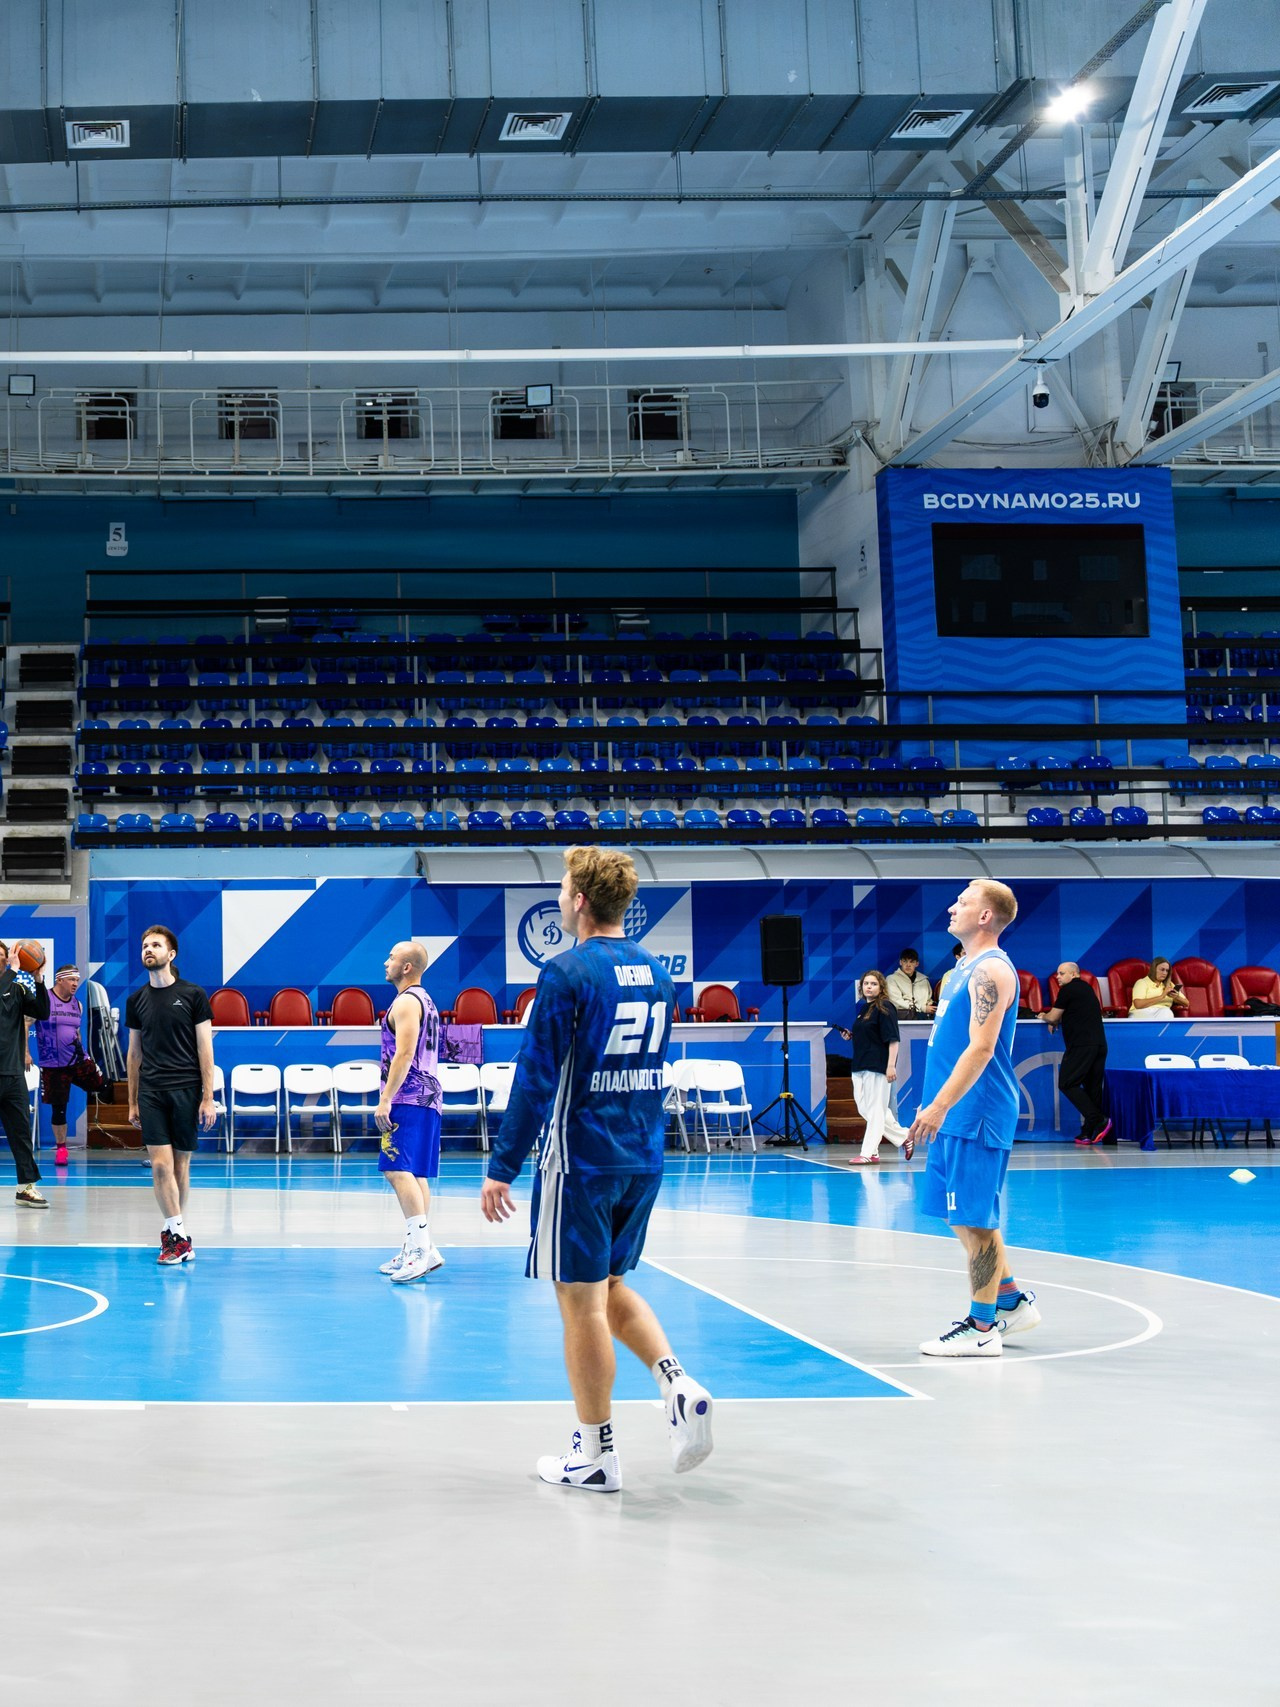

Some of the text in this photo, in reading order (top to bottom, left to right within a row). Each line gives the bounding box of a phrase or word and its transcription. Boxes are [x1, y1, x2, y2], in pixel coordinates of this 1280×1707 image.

[923, 492, 1141, 509] BCDYNAMO25.RU
[112, 527, 122, 541] 5
[614, 964, 655, 987] ОЛЕНИН
[603, 1001, 668, 1056] 21
